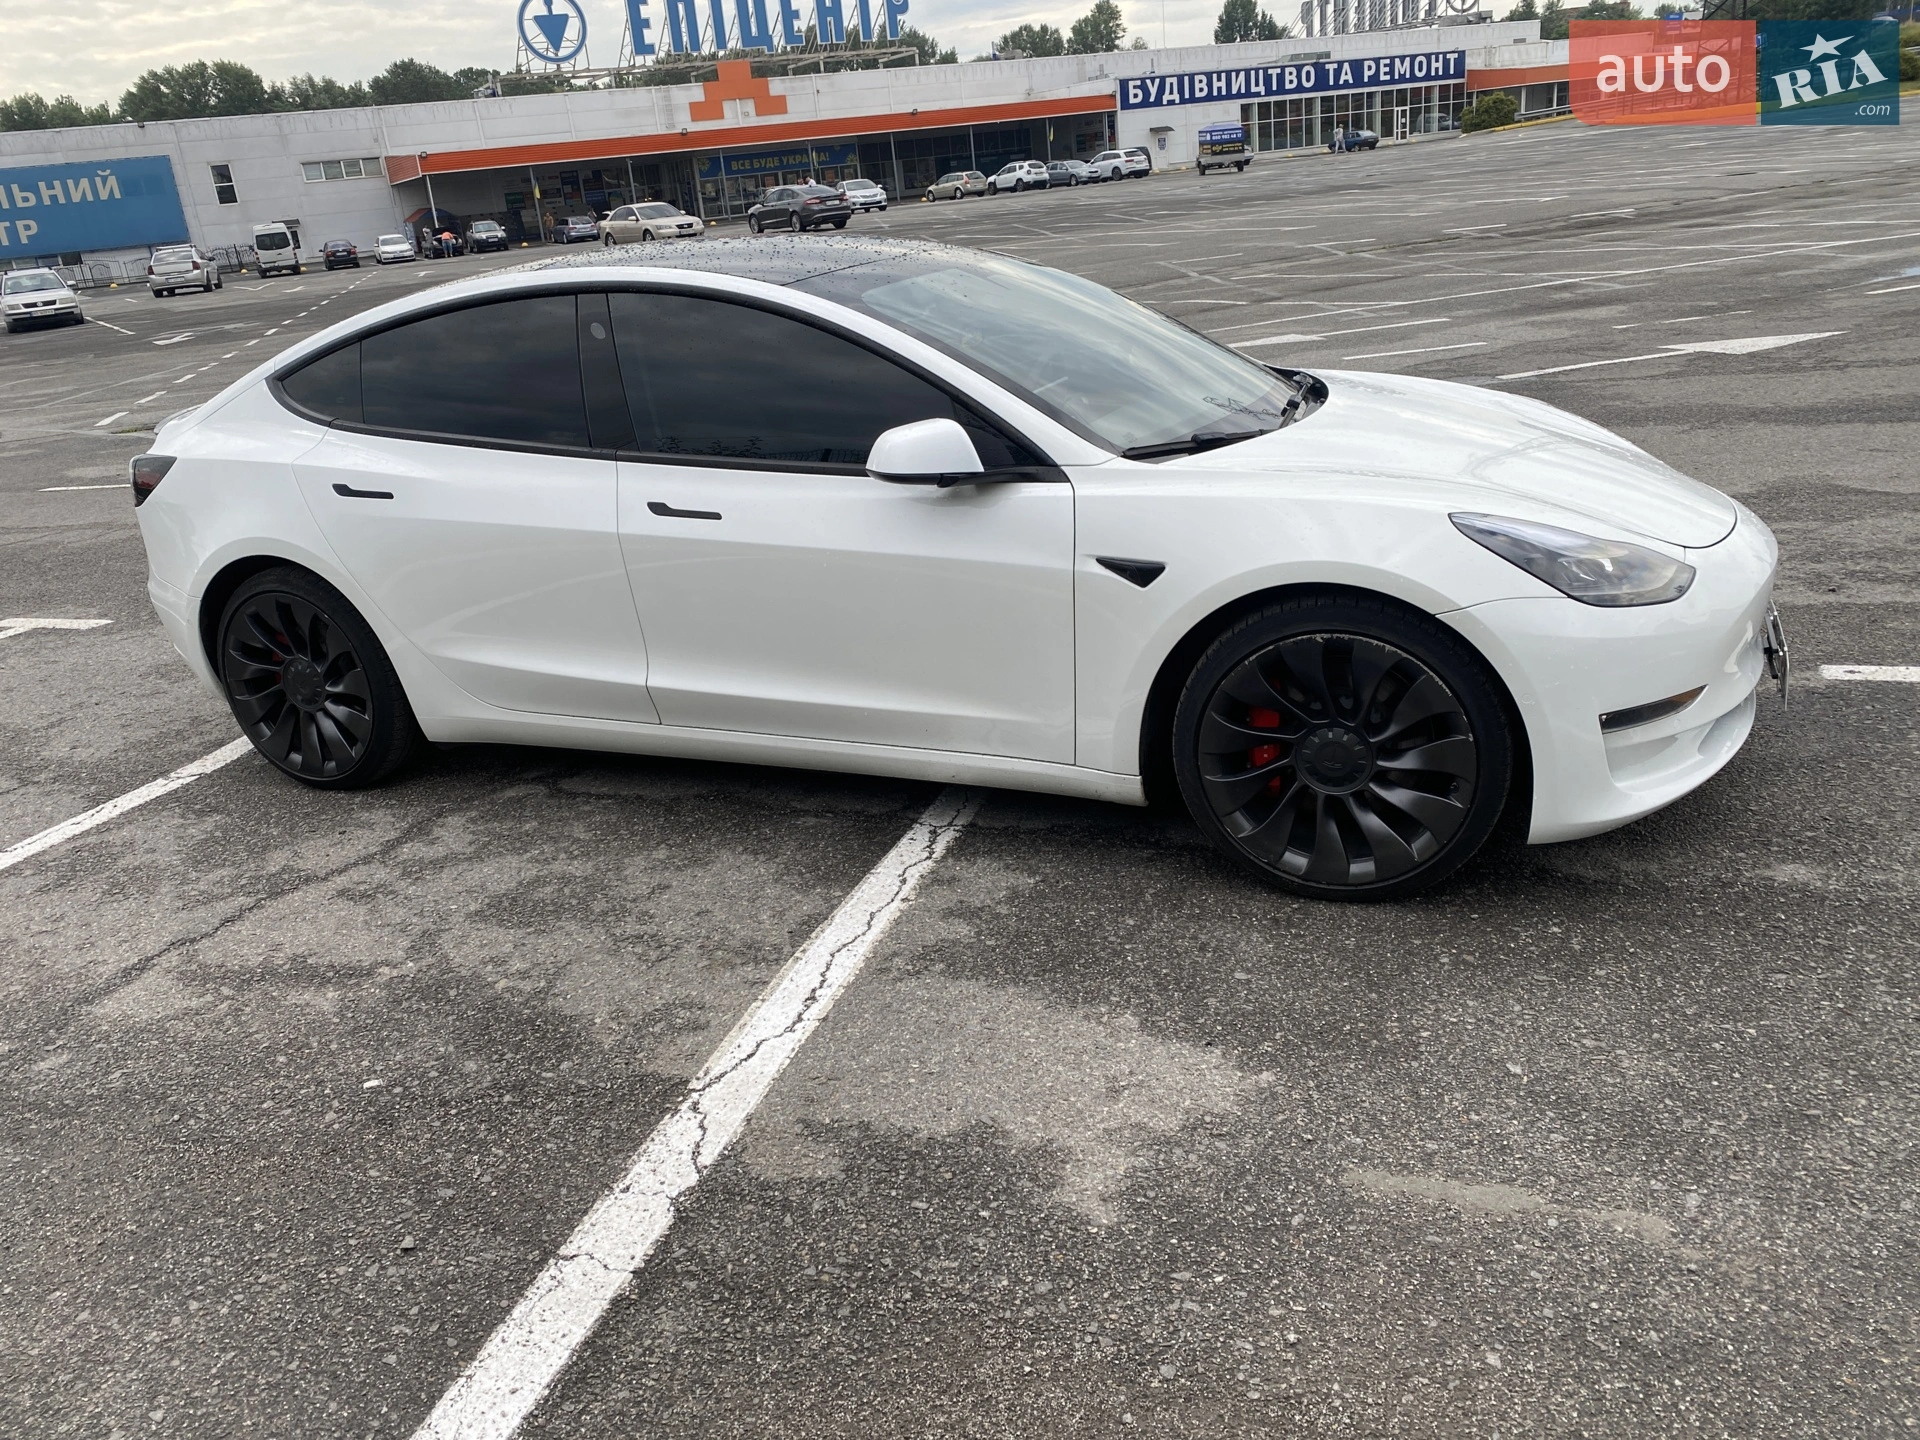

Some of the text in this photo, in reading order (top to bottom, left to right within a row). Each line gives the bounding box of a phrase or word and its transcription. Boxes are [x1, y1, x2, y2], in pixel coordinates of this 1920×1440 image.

[1127, 52, 1459, 106] БУДІВНИЦТВО ТА РЕМОНТ
[730, 151, 830, 171] ВСЕ БУДЕ УКРАНА!
